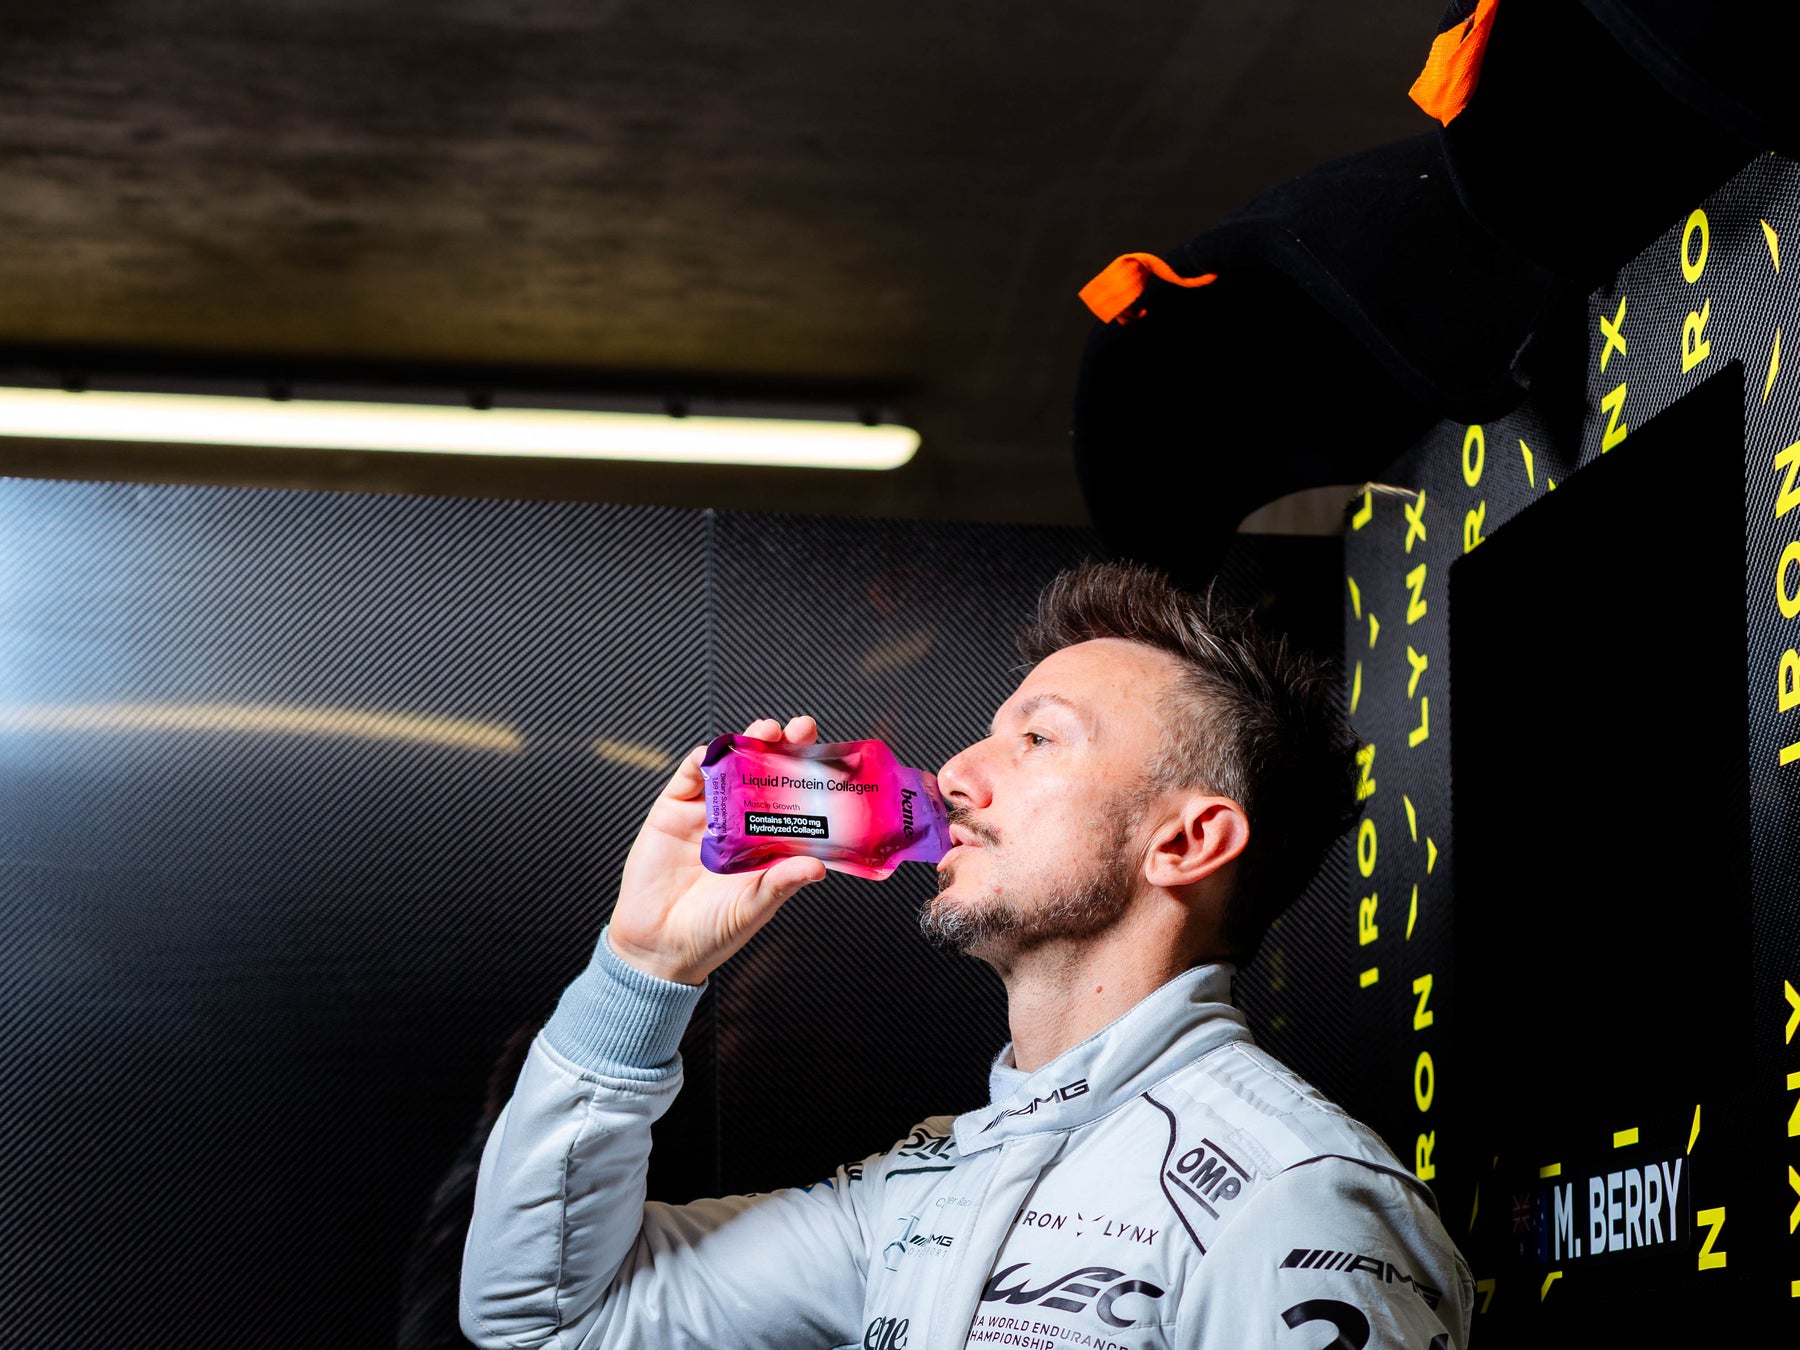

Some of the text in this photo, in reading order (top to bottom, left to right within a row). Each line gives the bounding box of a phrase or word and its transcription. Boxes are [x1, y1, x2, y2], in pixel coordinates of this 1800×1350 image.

[742, 774, 879, 795] Liquid Protein Collagen
[743, 800, 801, 811] Muscle Growth
[749, 815, 783, 825] Contains
[808, 820, 821, 828] mg
[901, 788, 917, 840] beme
[749, 824, 825, 836] Hydrolyzed Collagen
[1405, 489, 1436, 1181] RON LYNX
[1355, 743, 1379, 988] IRON
[1176, 1147, 1242, 1202] OMP
[1553, 1182, 1582, 1261] M.
[1588, 1157, 1683, 1256] BERRY
[1103, 1220, 1160, 1246] LYNX
[979, 1262, 1165, 1328] WEC
[988, 1316, 1030, 1332] WORLD
